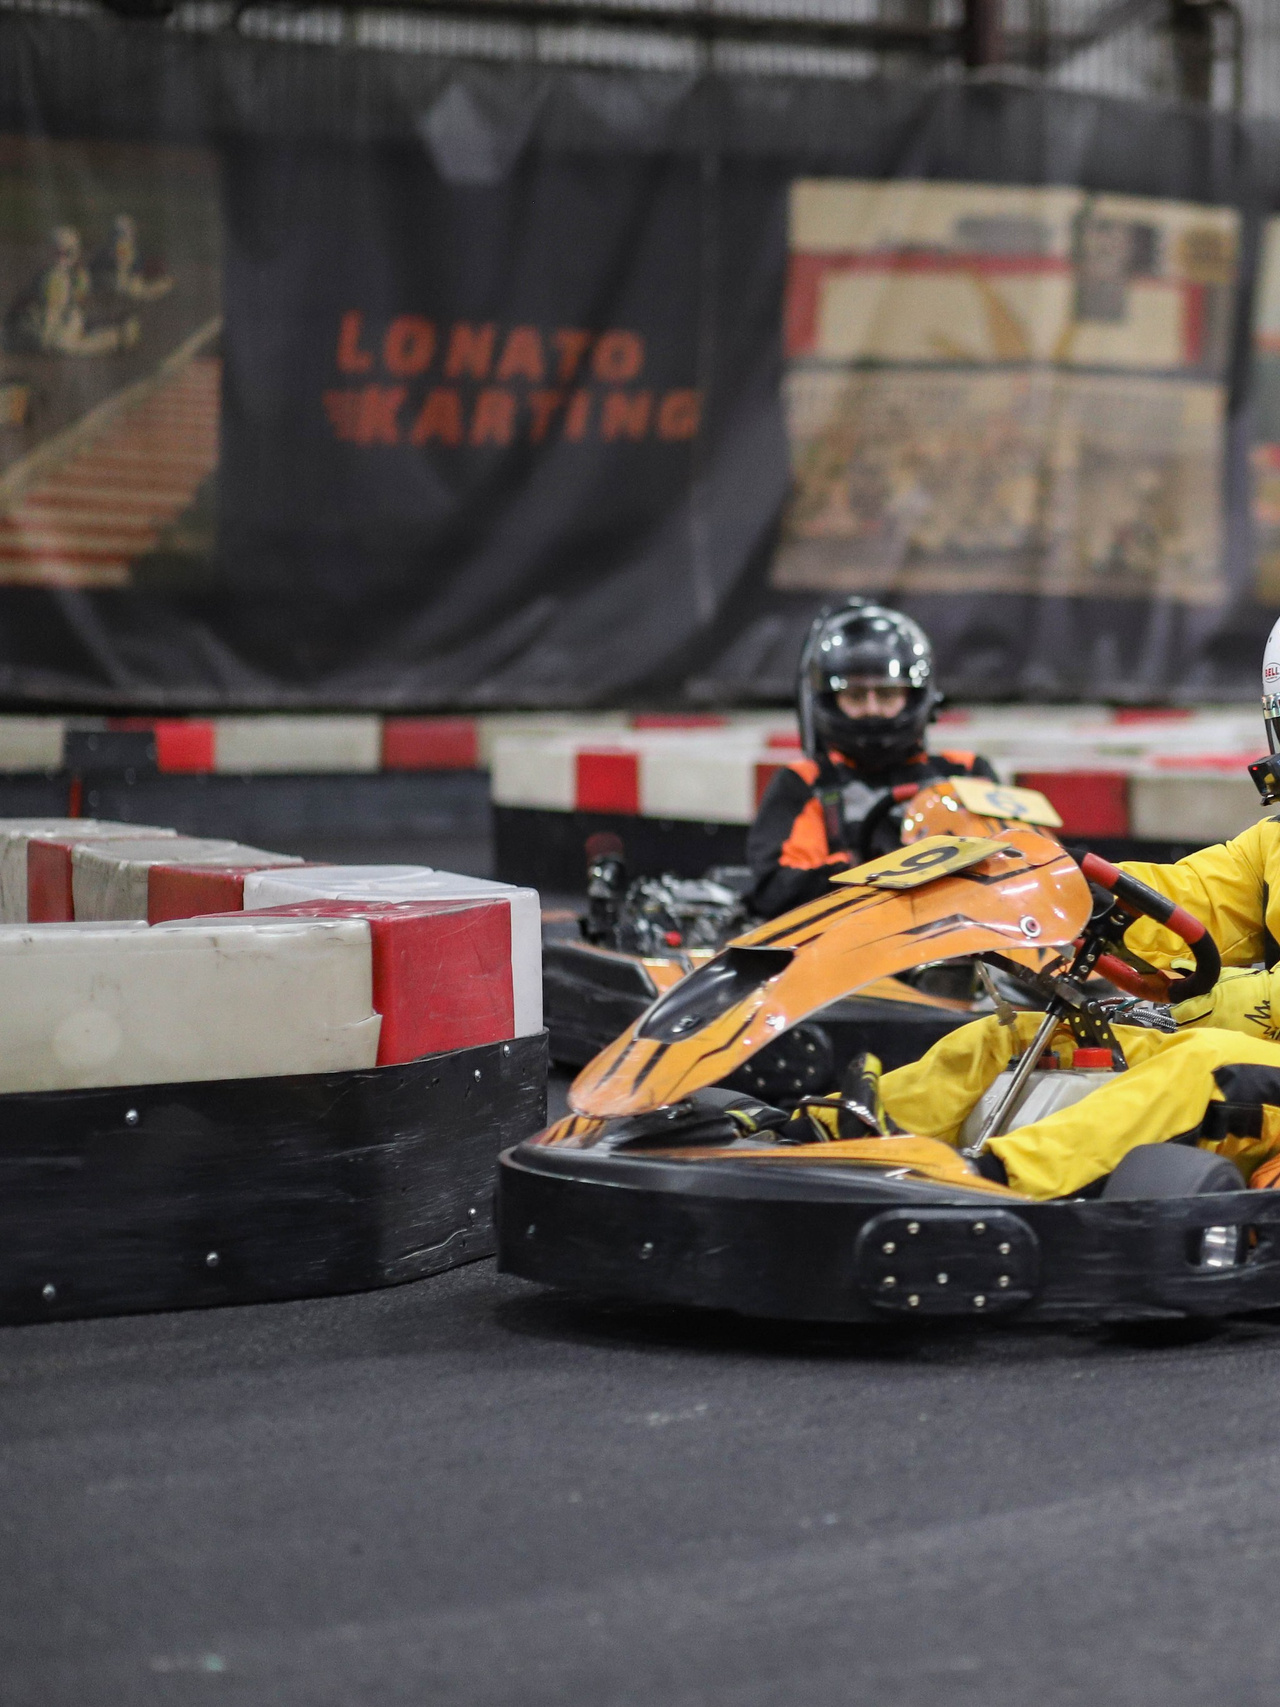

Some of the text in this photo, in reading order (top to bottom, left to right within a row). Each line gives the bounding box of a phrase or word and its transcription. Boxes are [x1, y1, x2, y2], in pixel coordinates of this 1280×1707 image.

[336, 309, 646, 384] LONATO
[352, 384, 704, 448] KARTING
[1265, 667, 1280, 678] BELL
[878, 846, 960, 877] 9
